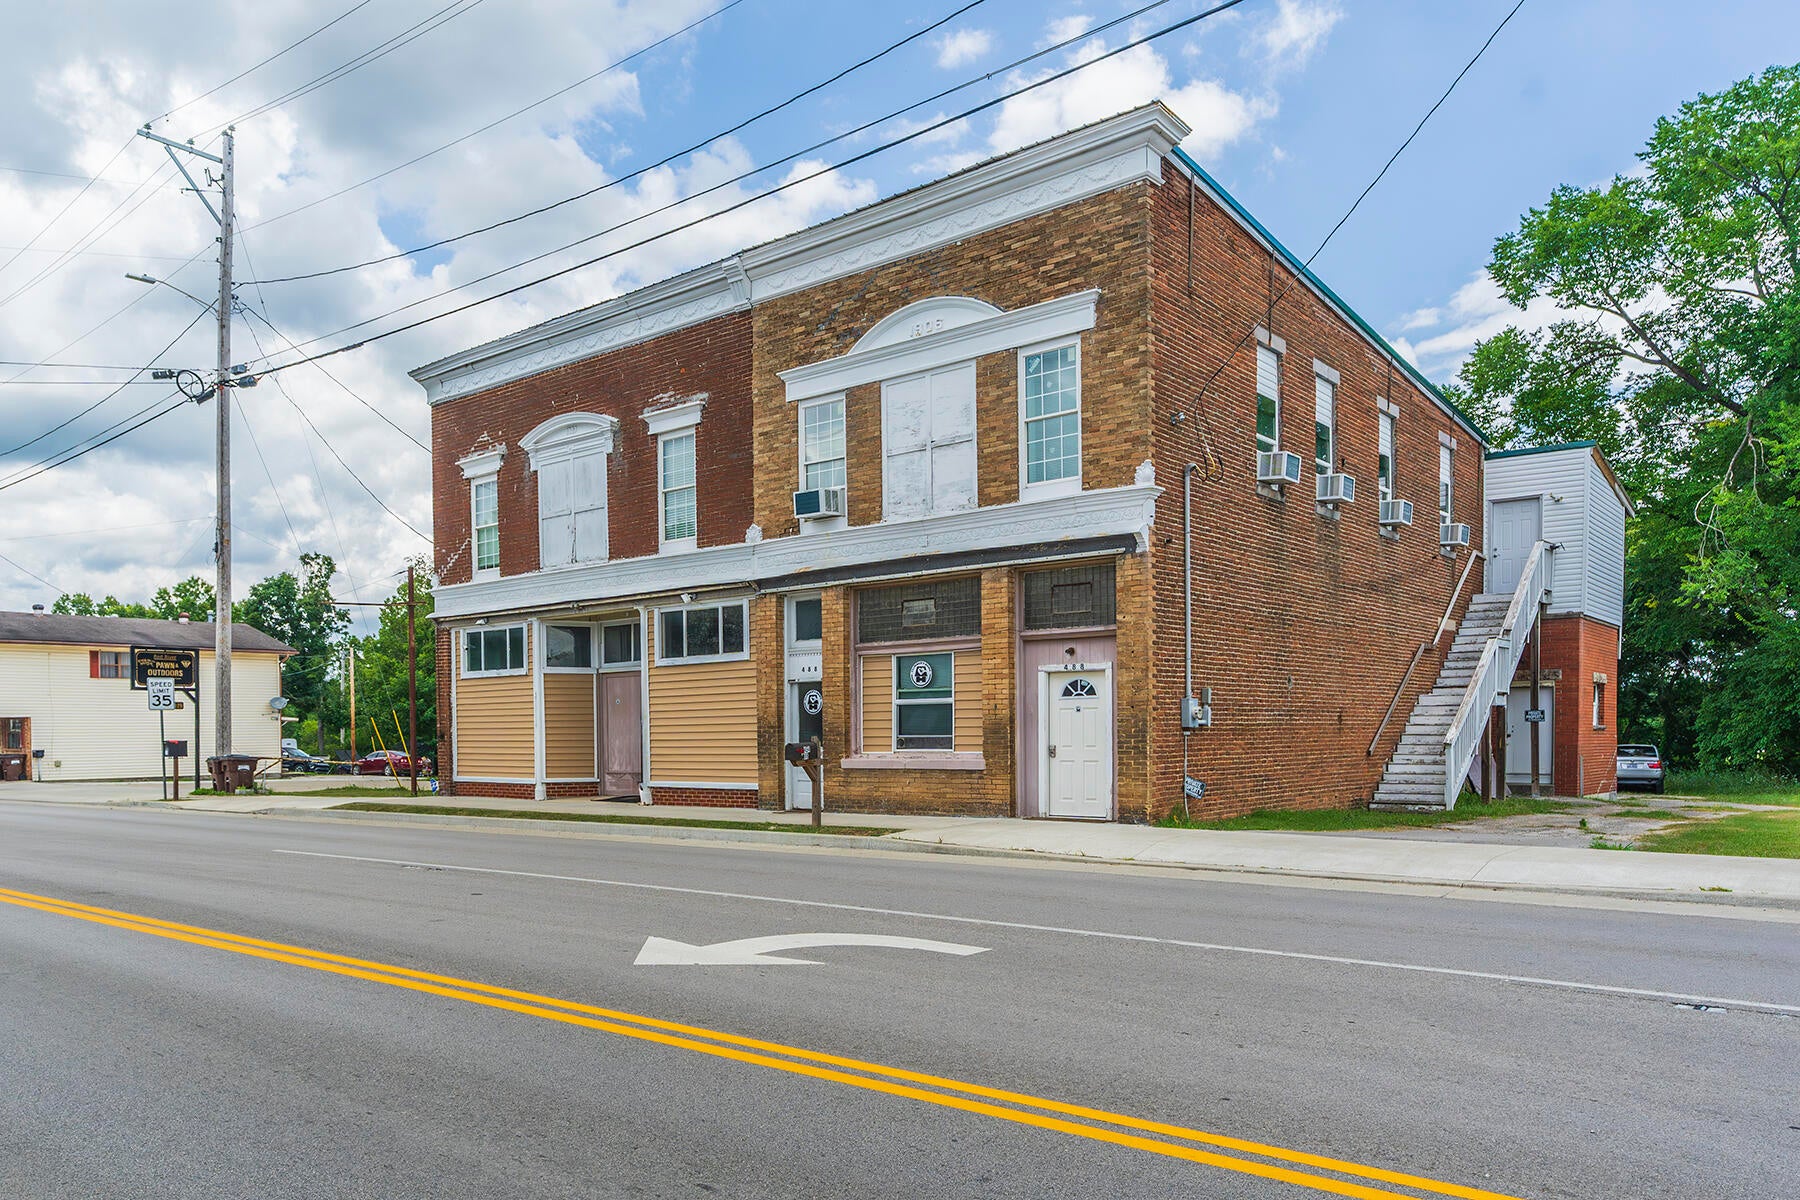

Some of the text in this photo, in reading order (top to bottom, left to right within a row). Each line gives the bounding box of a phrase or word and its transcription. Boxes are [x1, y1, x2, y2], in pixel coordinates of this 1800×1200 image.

[155, 661, 175, 669] PAWN
[147, 669, 184, 677] OUTDOORS
[152, 694, 172, 707] 35
